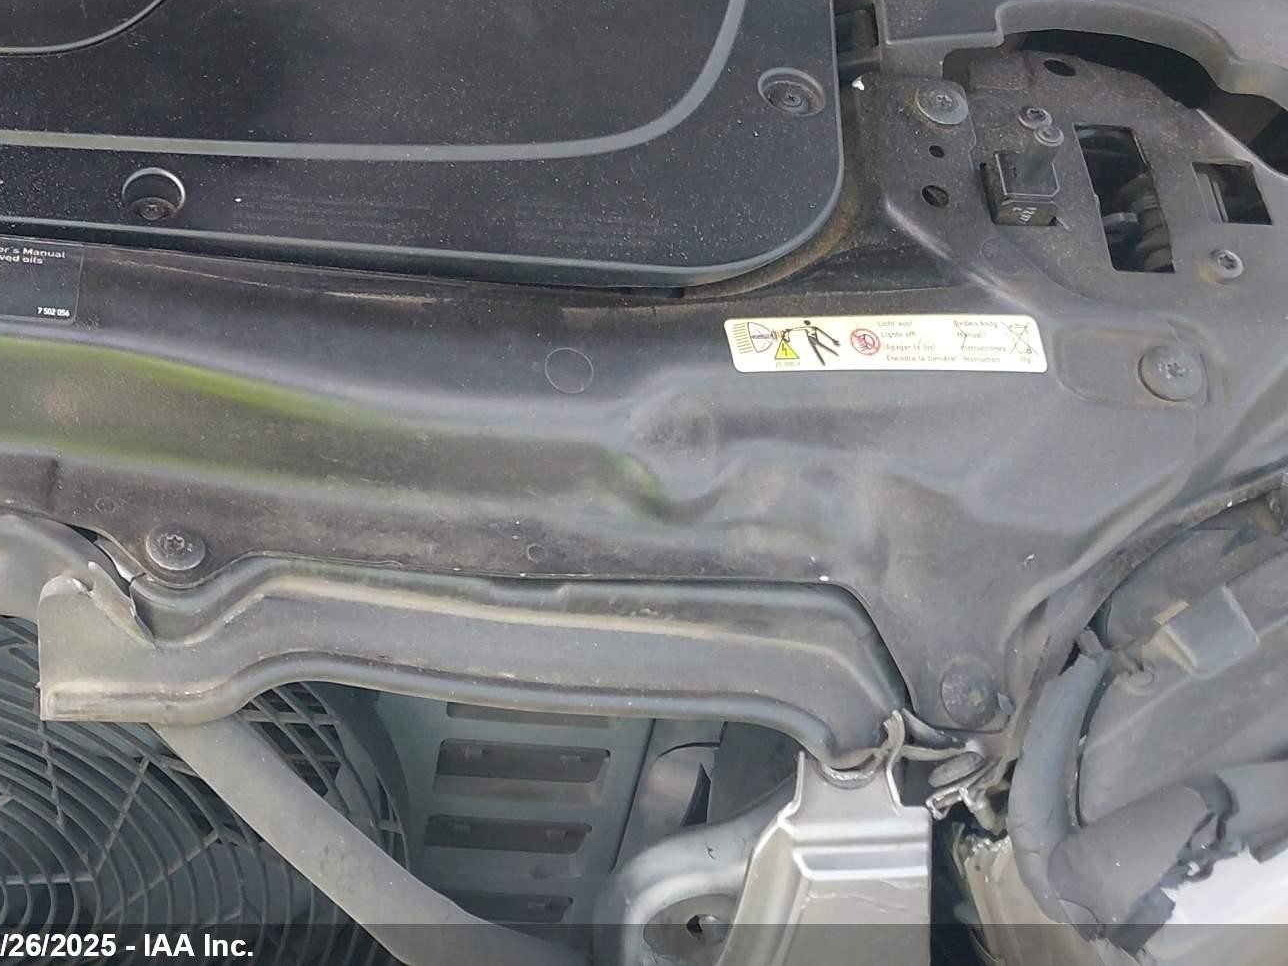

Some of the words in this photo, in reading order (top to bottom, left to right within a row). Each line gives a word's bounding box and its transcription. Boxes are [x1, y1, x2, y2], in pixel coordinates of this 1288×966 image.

[22, 247, 66, 259] Manual
[22, 255, 43, 264] oils
[37, 306, 43, 315] 7
[43, 307, 56, 316] 502
